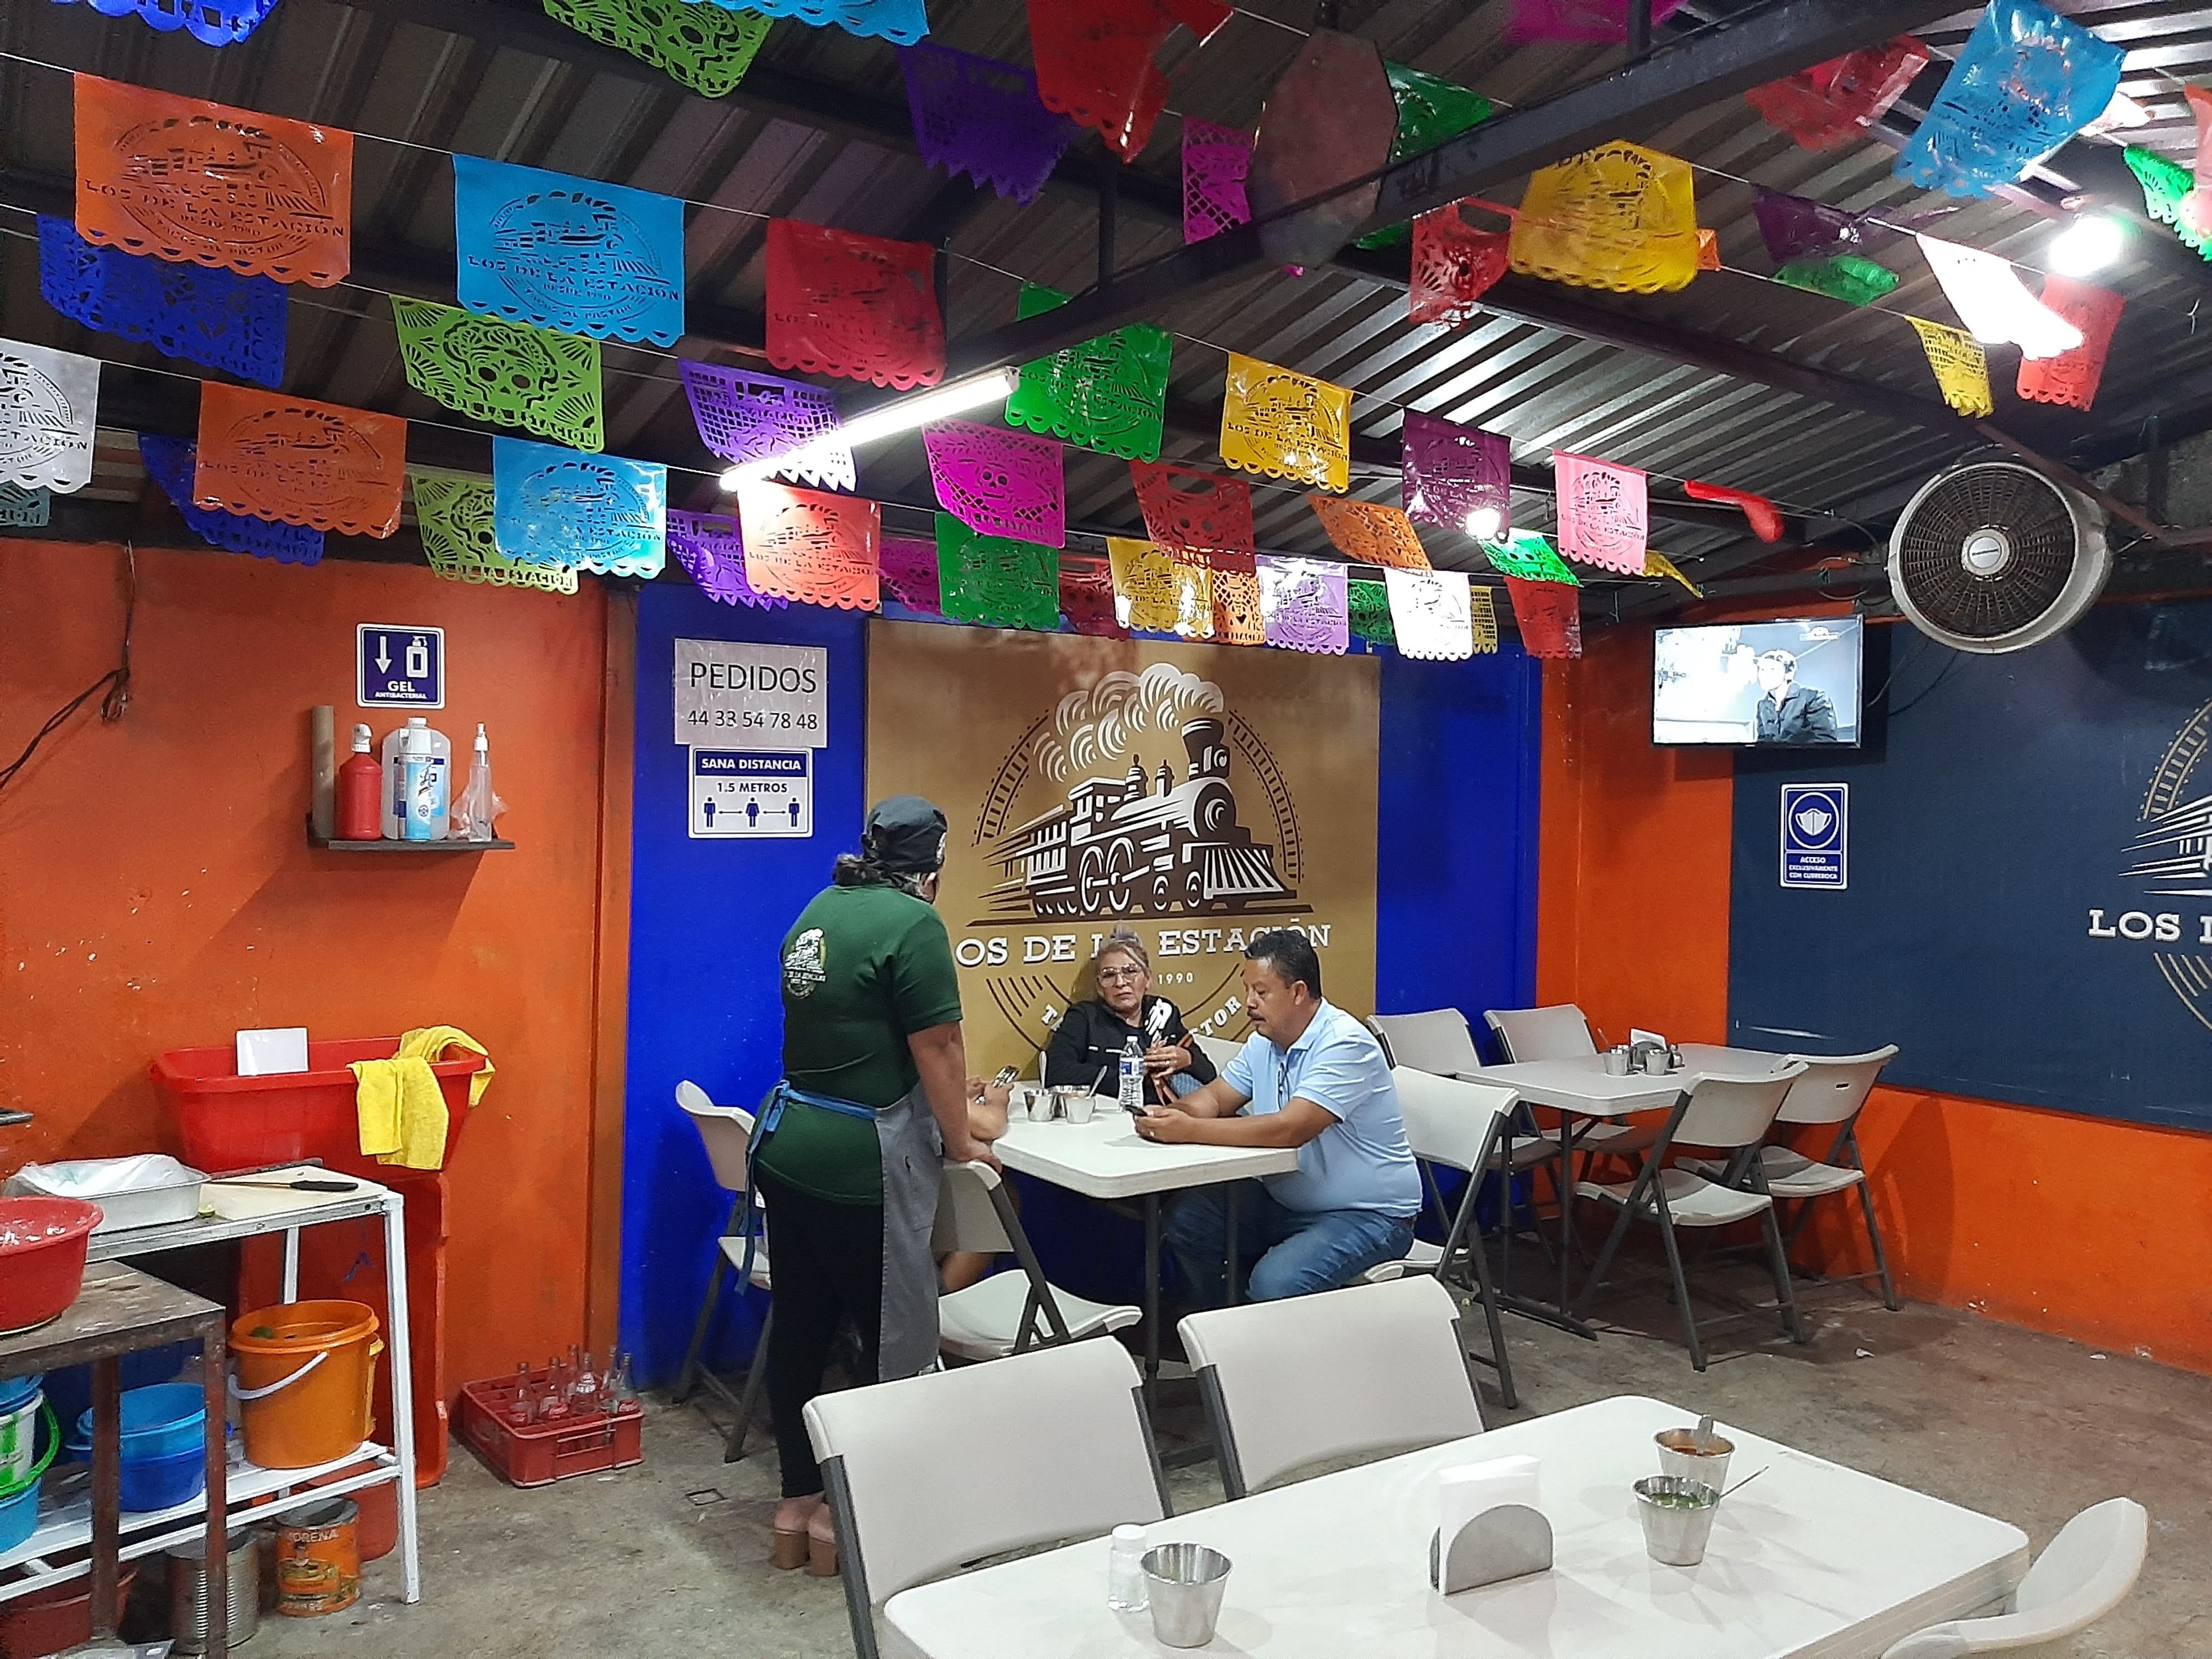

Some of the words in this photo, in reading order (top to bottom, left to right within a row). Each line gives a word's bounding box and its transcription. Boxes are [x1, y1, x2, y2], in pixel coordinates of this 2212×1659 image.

[85, 180, 131, 200] LOS
[143, 194, 175, 208] DE
[186, 202, 218, 217] LA
[467, 255, 507, 271] LOS
[515, 265, 540, 278] DE
[547, 271, 575, 285] LA
[0, 429, 88, 450] STACIÓN
[1227, 421, 1250, 434] LOS
[1255, 429, 1273, 439] DE
[1276, 434, 1292, 443] LA
[387, 680, 415, 692] GEL
[690, 662, 816, 693] PEDIDOS
[688, 710, 709, 725] 44
[715, 711, 736, 727] 33
[742, 711, 764, 728] 54
[770, 712, 792, 729] 78
[797, 714, 818, 729] 48
[701, 758, 736, 769] SANA
[738, 759, 801, 770] DISTANCIA
[717, 782, 735, 793] 1.5
[739, 782, 788, 793] METROS
[2088, 909, 2180, 941] LOS
[956, 937, 1008, 967] OS
[1023, 934, 1076, 963] DE
[1158, 918, 1331, 956] ESTACN
[1158, 972, 1194, 985] 1990
